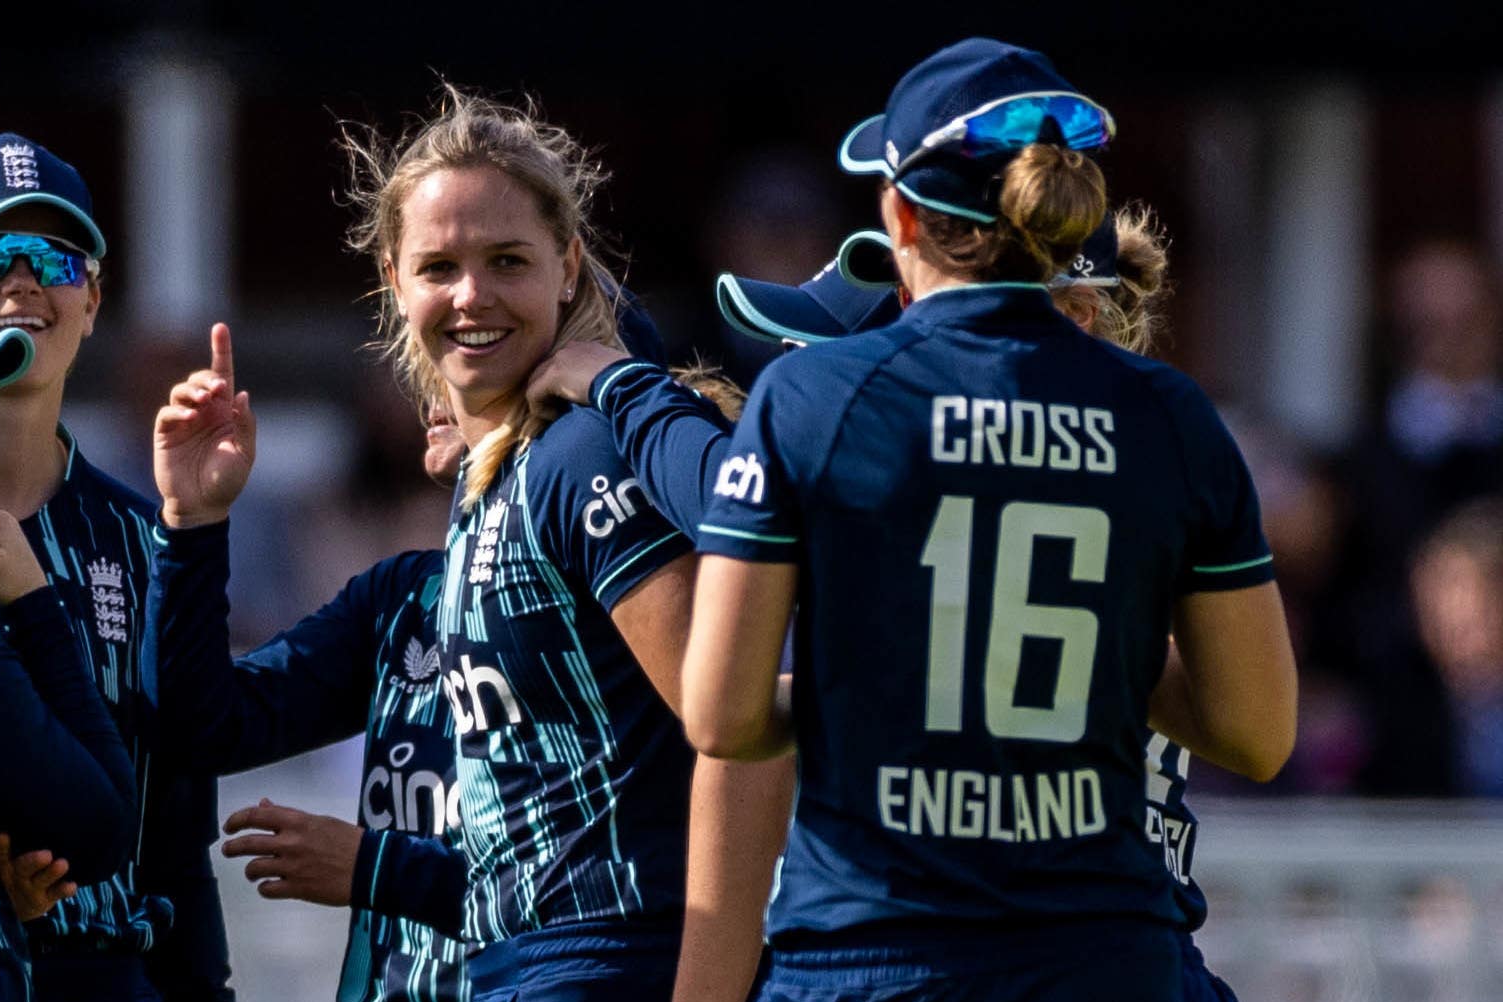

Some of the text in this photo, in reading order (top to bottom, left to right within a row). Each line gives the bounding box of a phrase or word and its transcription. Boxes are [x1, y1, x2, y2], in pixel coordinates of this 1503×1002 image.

[931, 396, 1117, 475] CROSS
[920, 495, 1111, 744] 16
[877, 766, 1107, 842] ENGLAND
